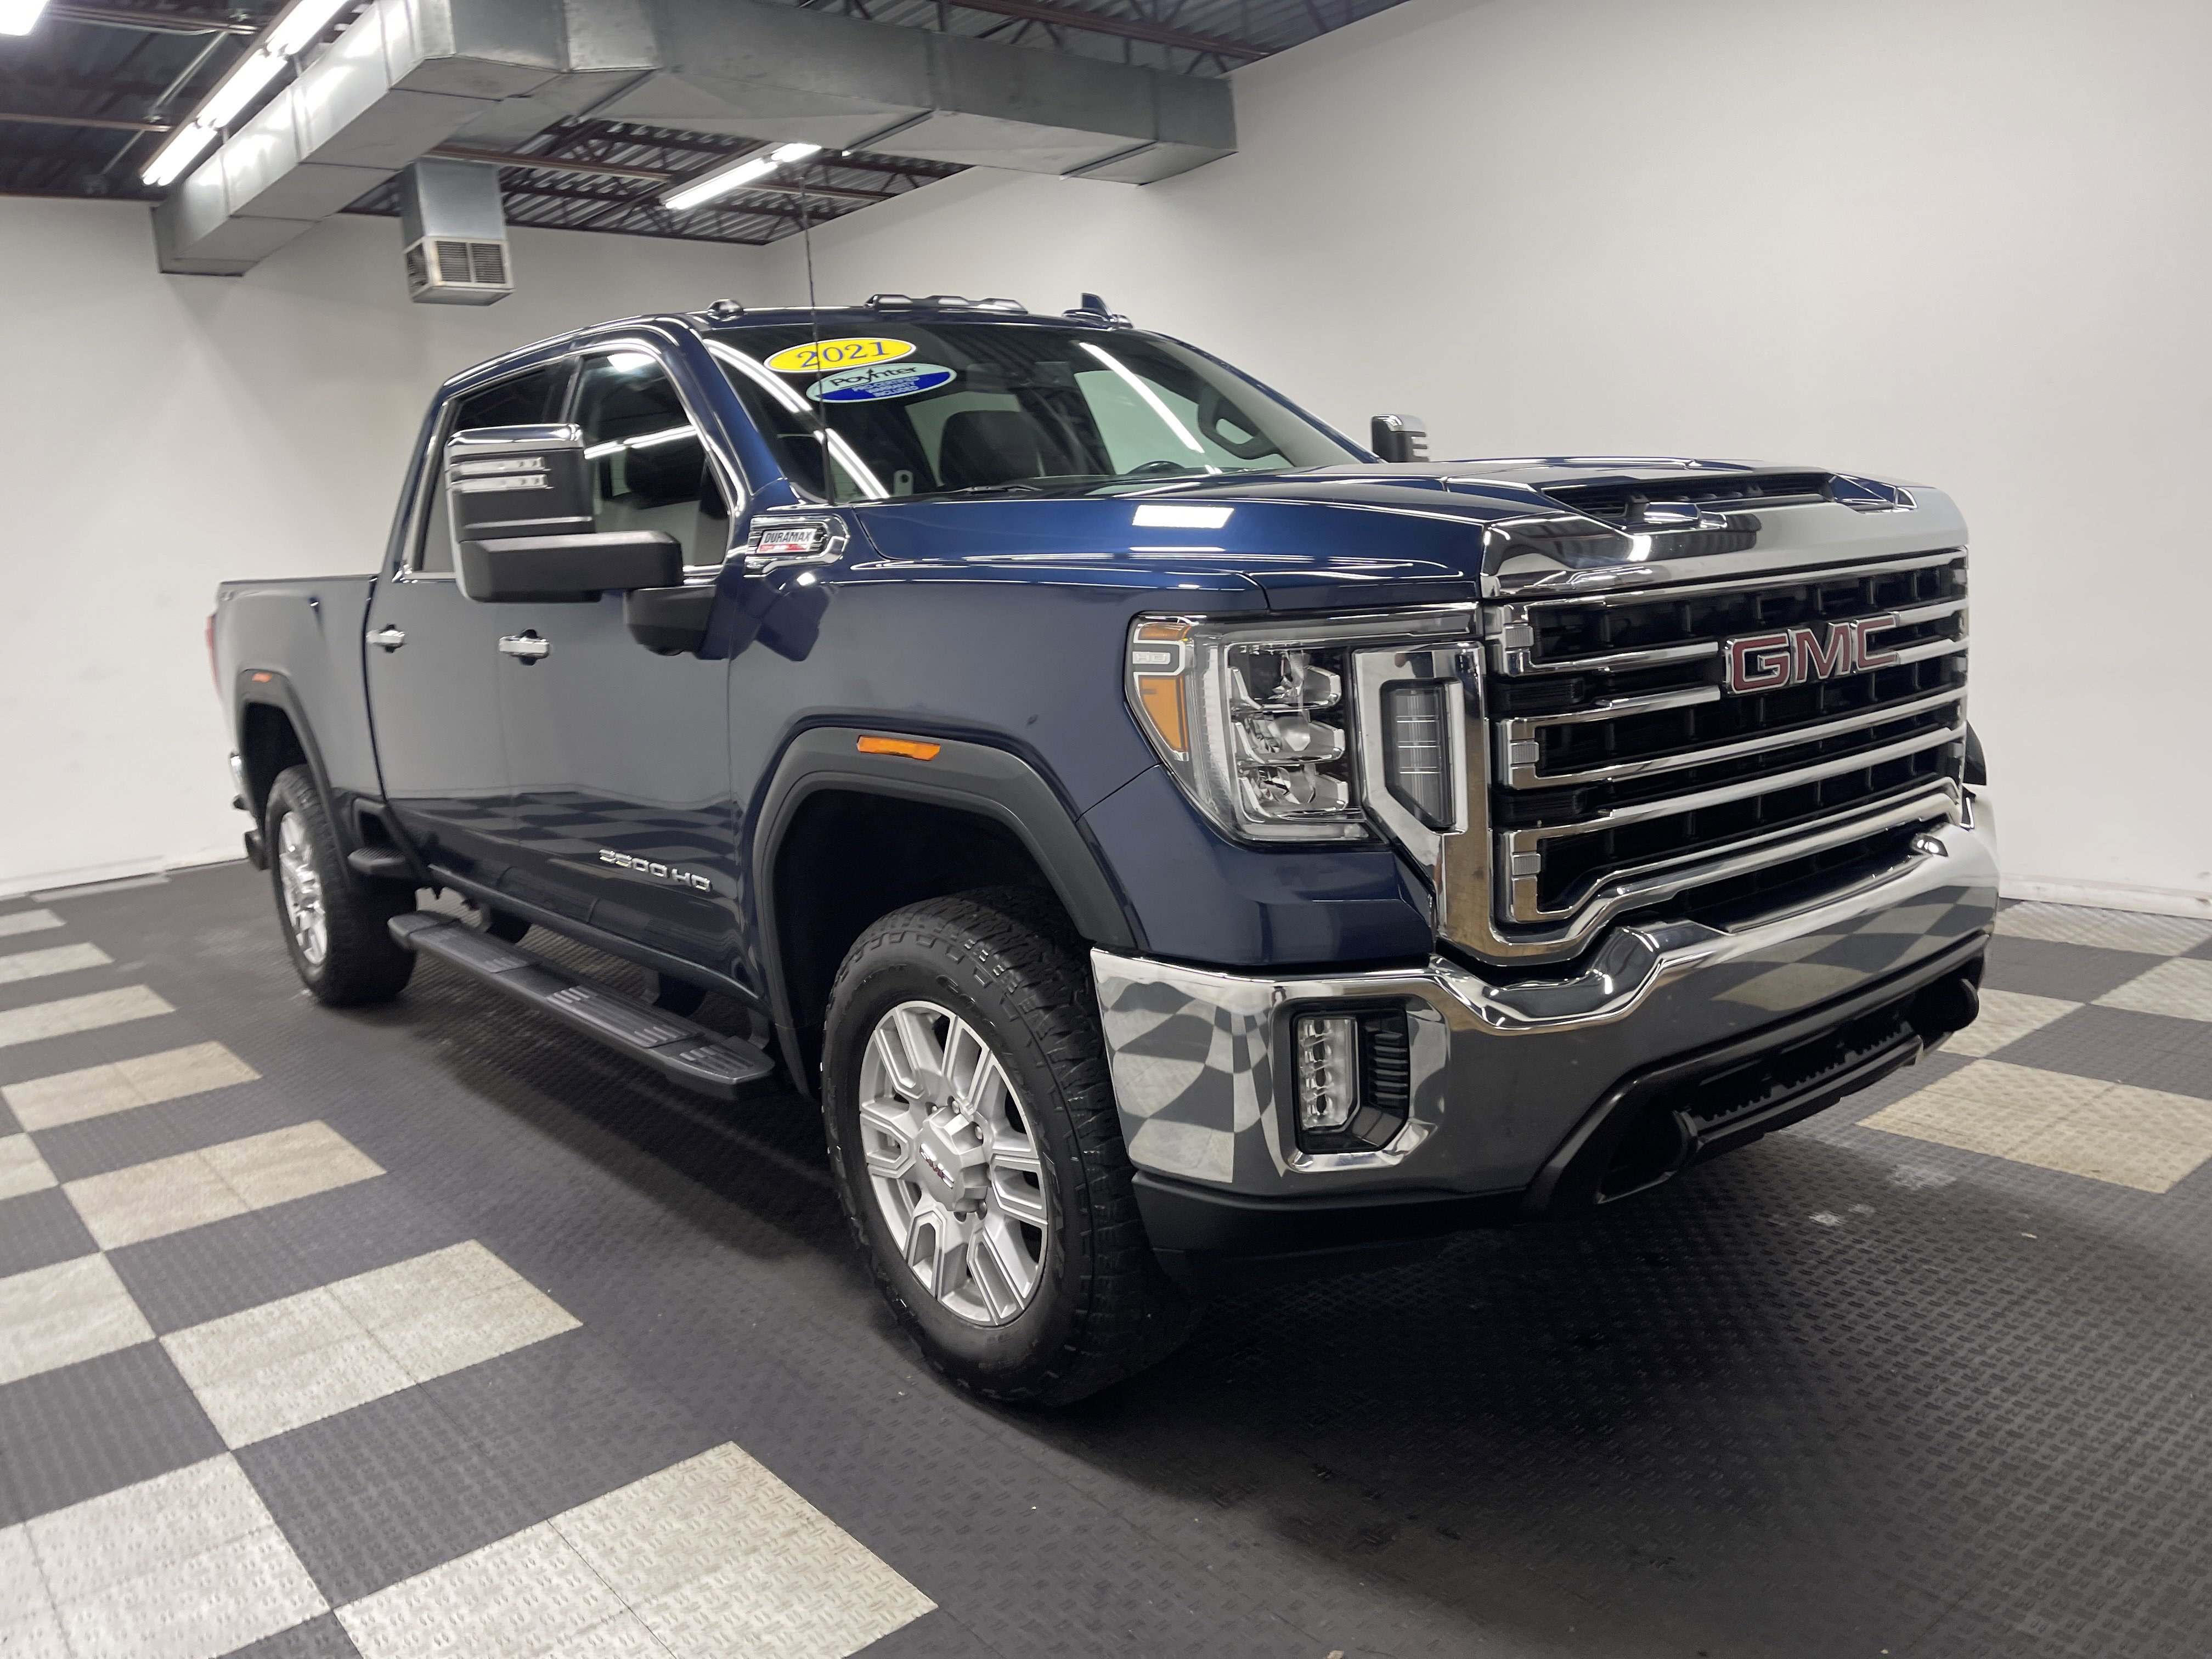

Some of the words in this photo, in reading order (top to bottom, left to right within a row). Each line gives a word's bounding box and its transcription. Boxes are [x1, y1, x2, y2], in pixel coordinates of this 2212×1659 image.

[797, 341, 890, 368] 2021
[764, 531, 813, 543] DURAMAX
[1135, 653, 1166, 663] HD
[1725, 612, 1901, 695] GMC
